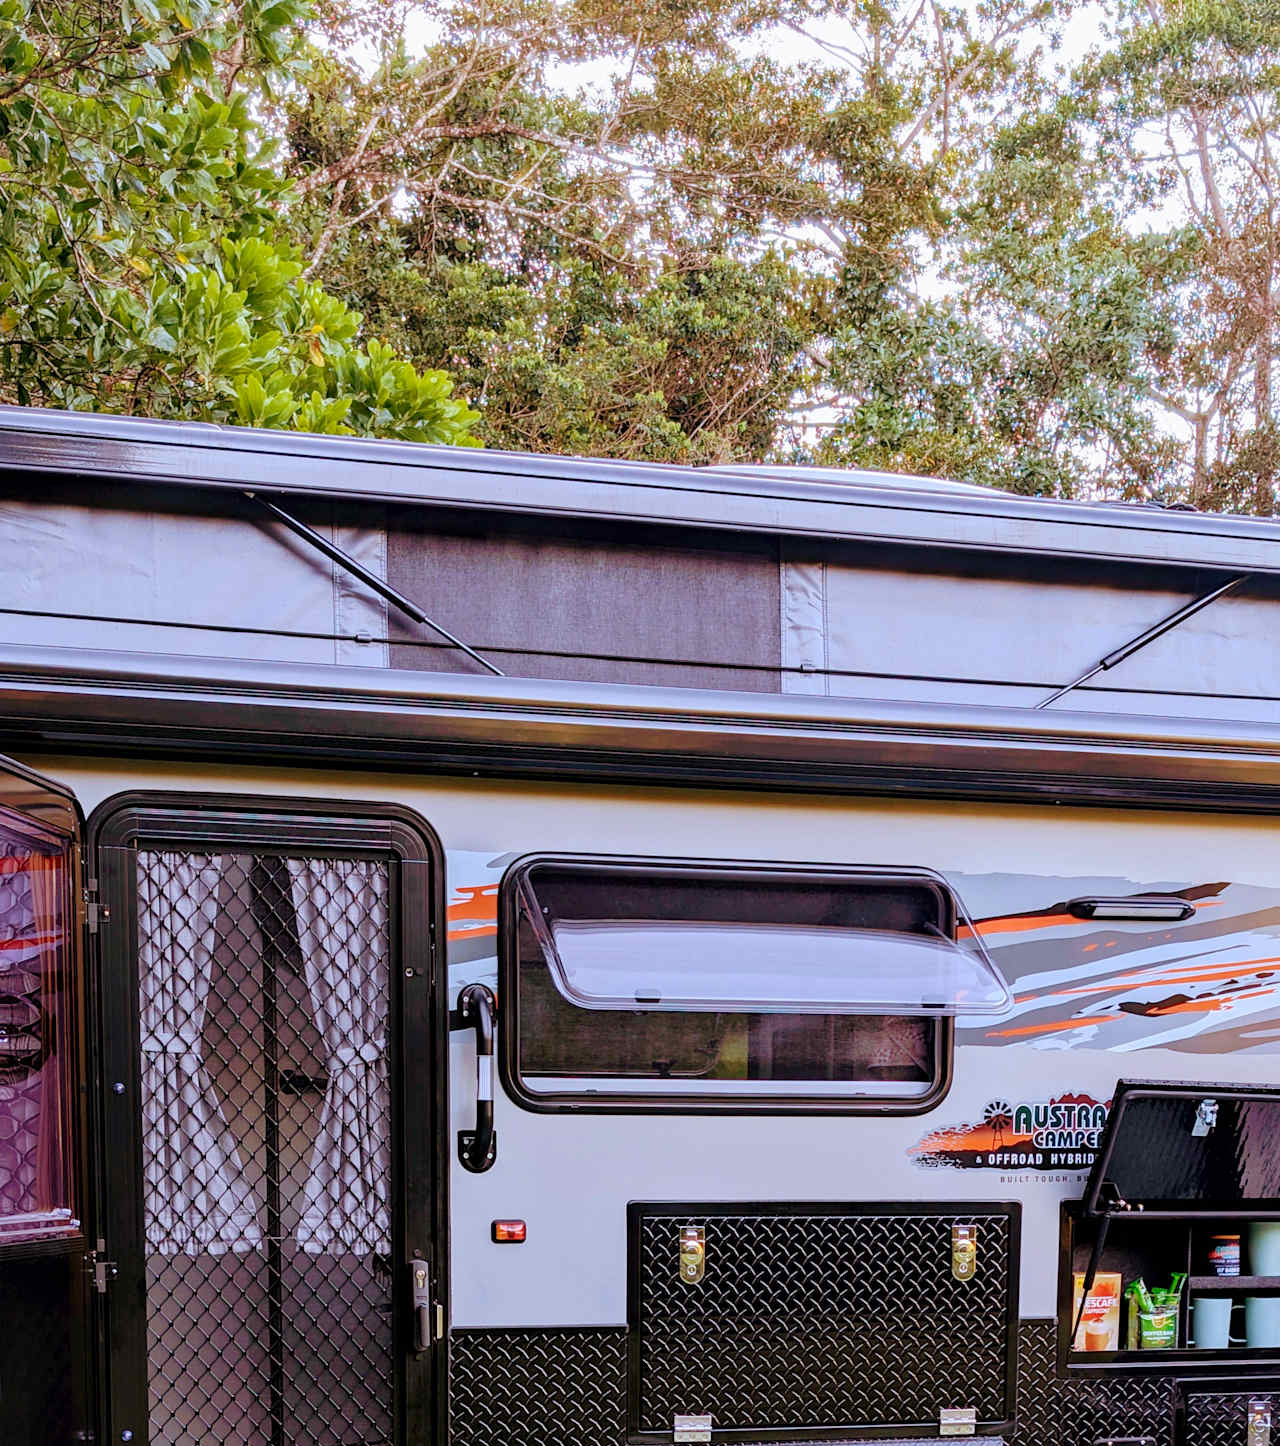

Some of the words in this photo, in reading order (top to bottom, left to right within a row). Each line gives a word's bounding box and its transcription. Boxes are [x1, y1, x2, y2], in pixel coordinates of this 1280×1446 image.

[1013, 1104, 1108, 1135] AUSTRA
[988, 1153, 1043, 1165] OFFROAD
[1050, 1153, 1099, 1165] HYBRID
[1000, 1175, 1029, 1183] BUILT
